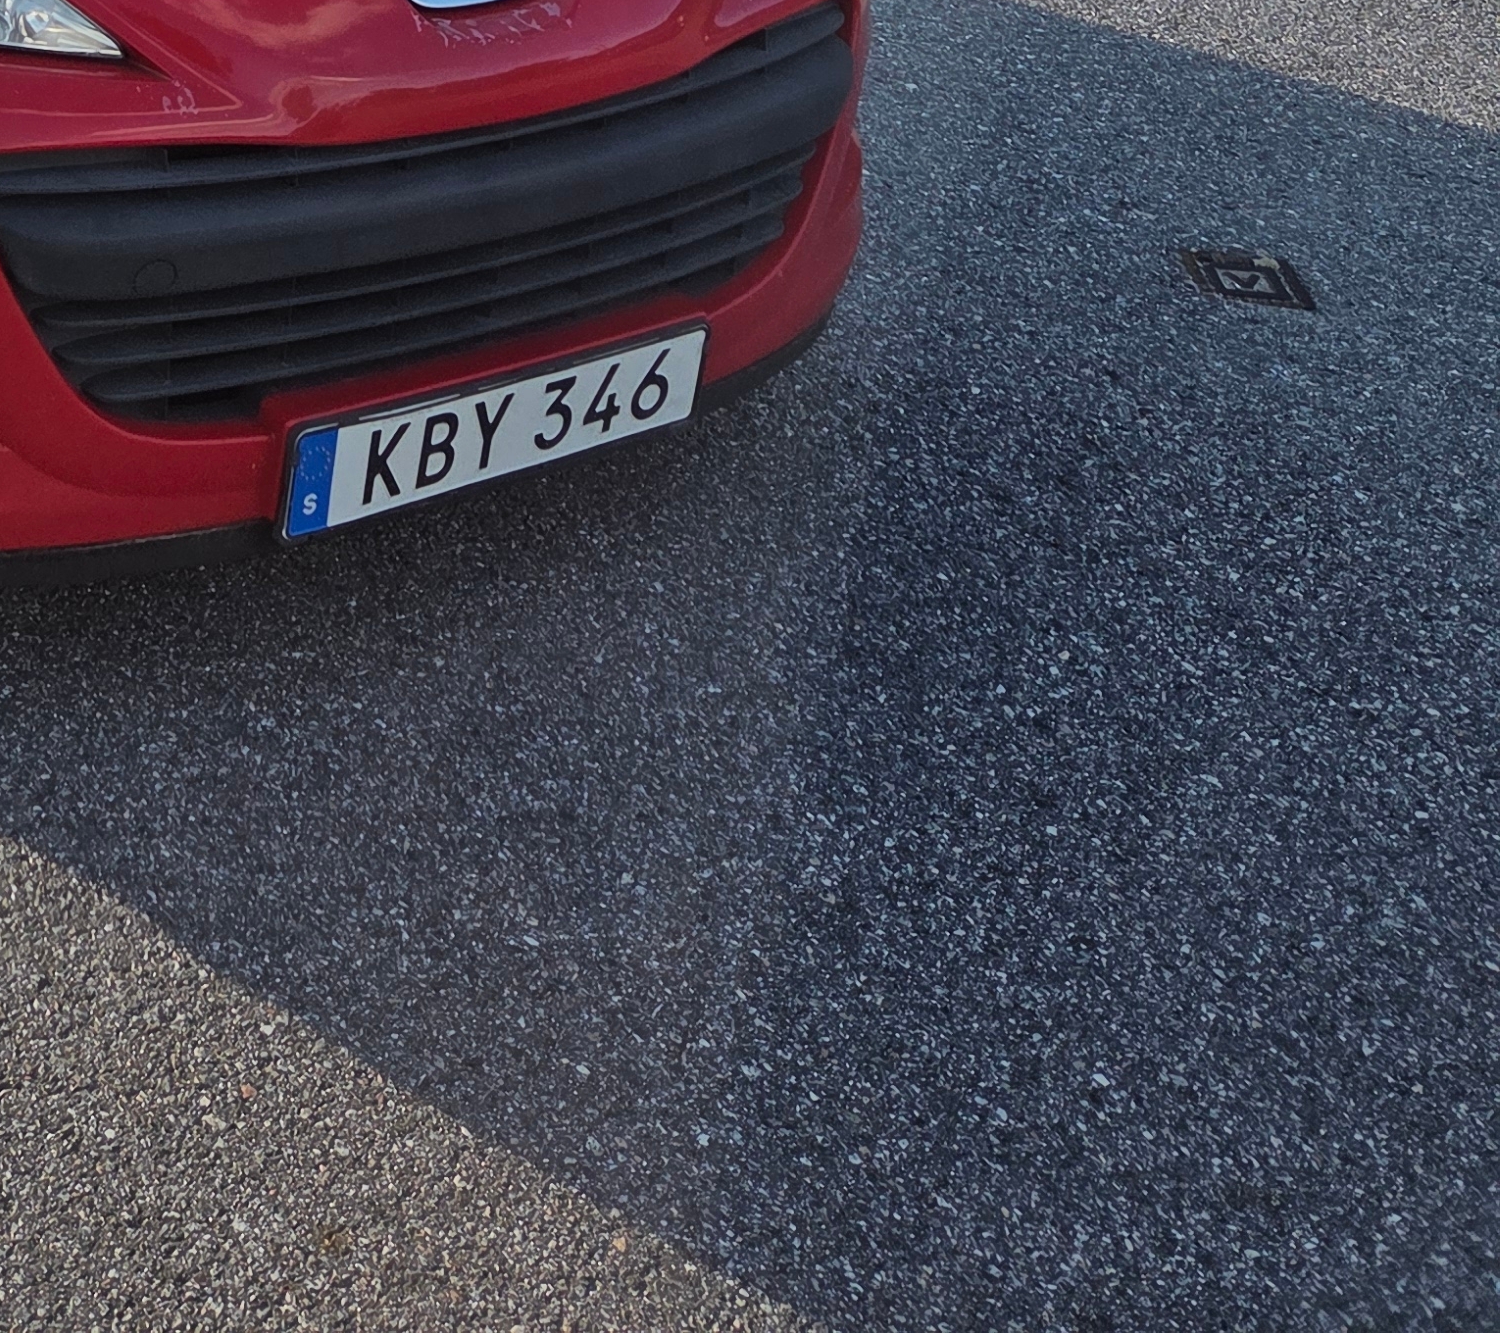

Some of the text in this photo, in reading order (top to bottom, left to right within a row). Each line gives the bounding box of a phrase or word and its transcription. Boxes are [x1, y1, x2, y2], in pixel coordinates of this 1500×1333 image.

[362, 348, 671, 506] KBY 346
[302, 492, 318, 515] S
